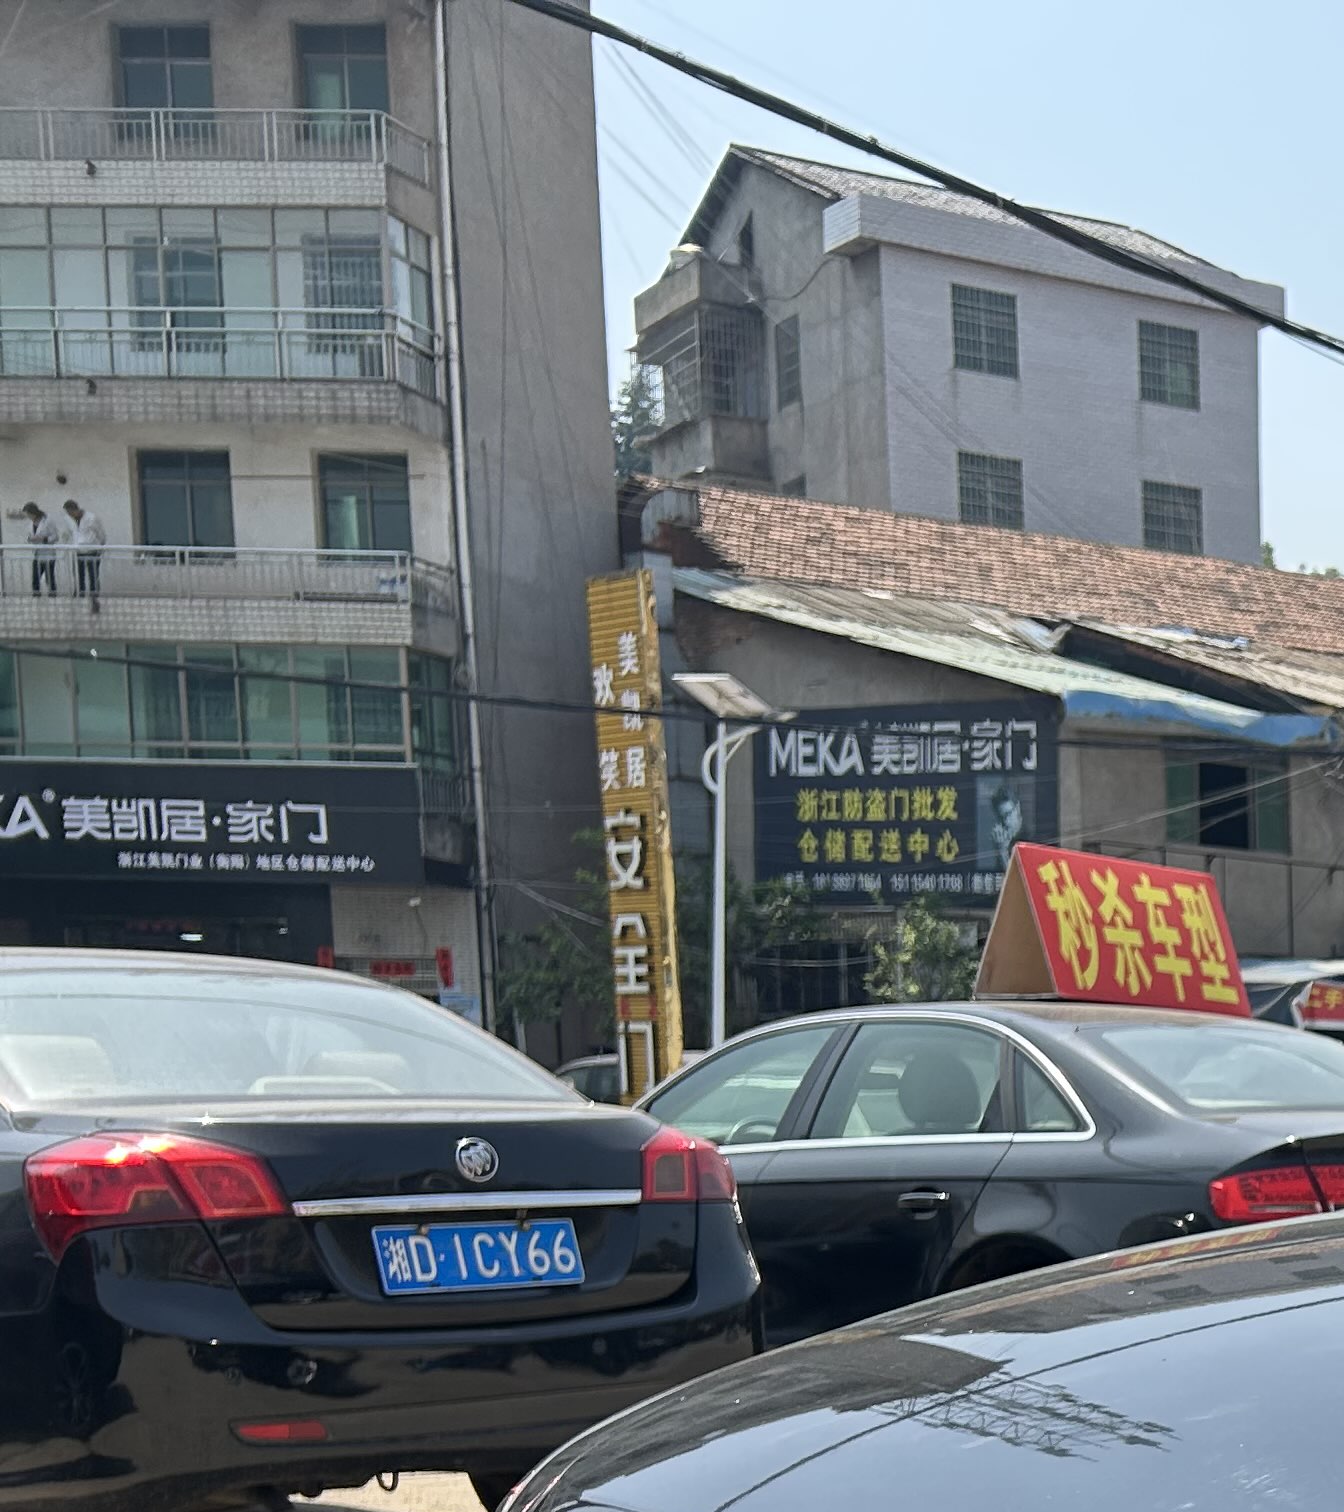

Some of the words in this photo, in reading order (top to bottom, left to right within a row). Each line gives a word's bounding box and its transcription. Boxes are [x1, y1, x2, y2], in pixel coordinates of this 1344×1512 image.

[768, 726, 865, 778] MEKA
[61, 796, 329, 845] 美凯居·家门
[796, 785, 959, 823] 浙江防盗门批发
[797, 826, 960, 864] 仓储配送中心
[603, 808, 656, 1096] 安全门
[1037, 859, 1240, 1005] 秒杀车型
